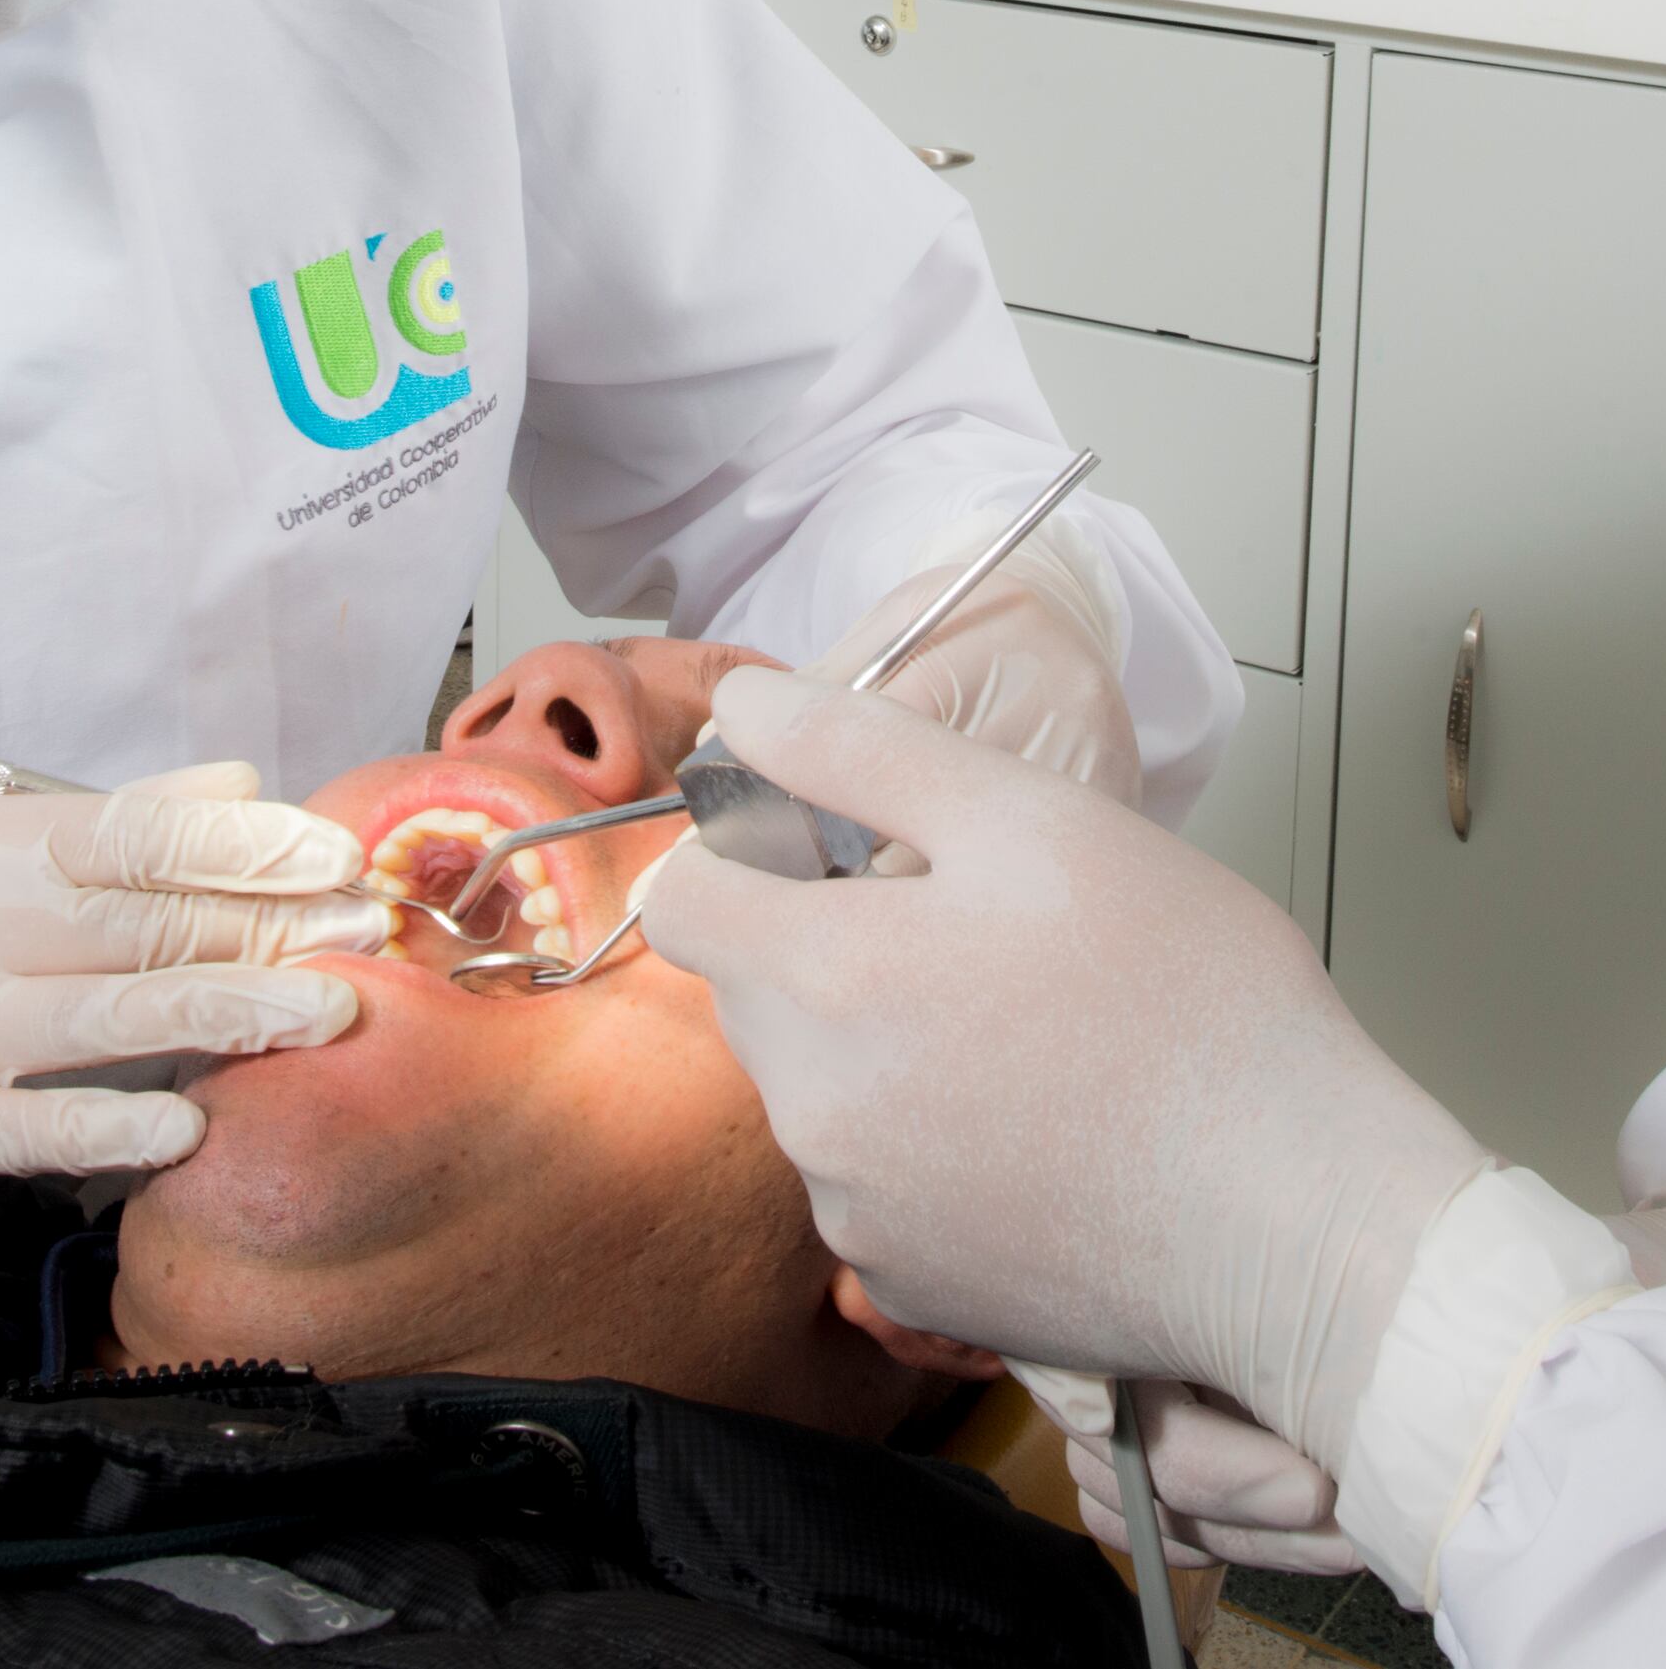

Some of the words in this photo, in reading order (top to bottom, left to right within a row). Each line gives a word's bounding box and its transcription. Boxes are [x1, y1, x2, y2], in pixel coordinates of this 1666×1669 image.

[276, 456, 395, 532] Universidad
[399, 393, 499, 469] Cooperativa
[347, 501, 375, 529] de
[377, 449, 460, 510] Colombia
